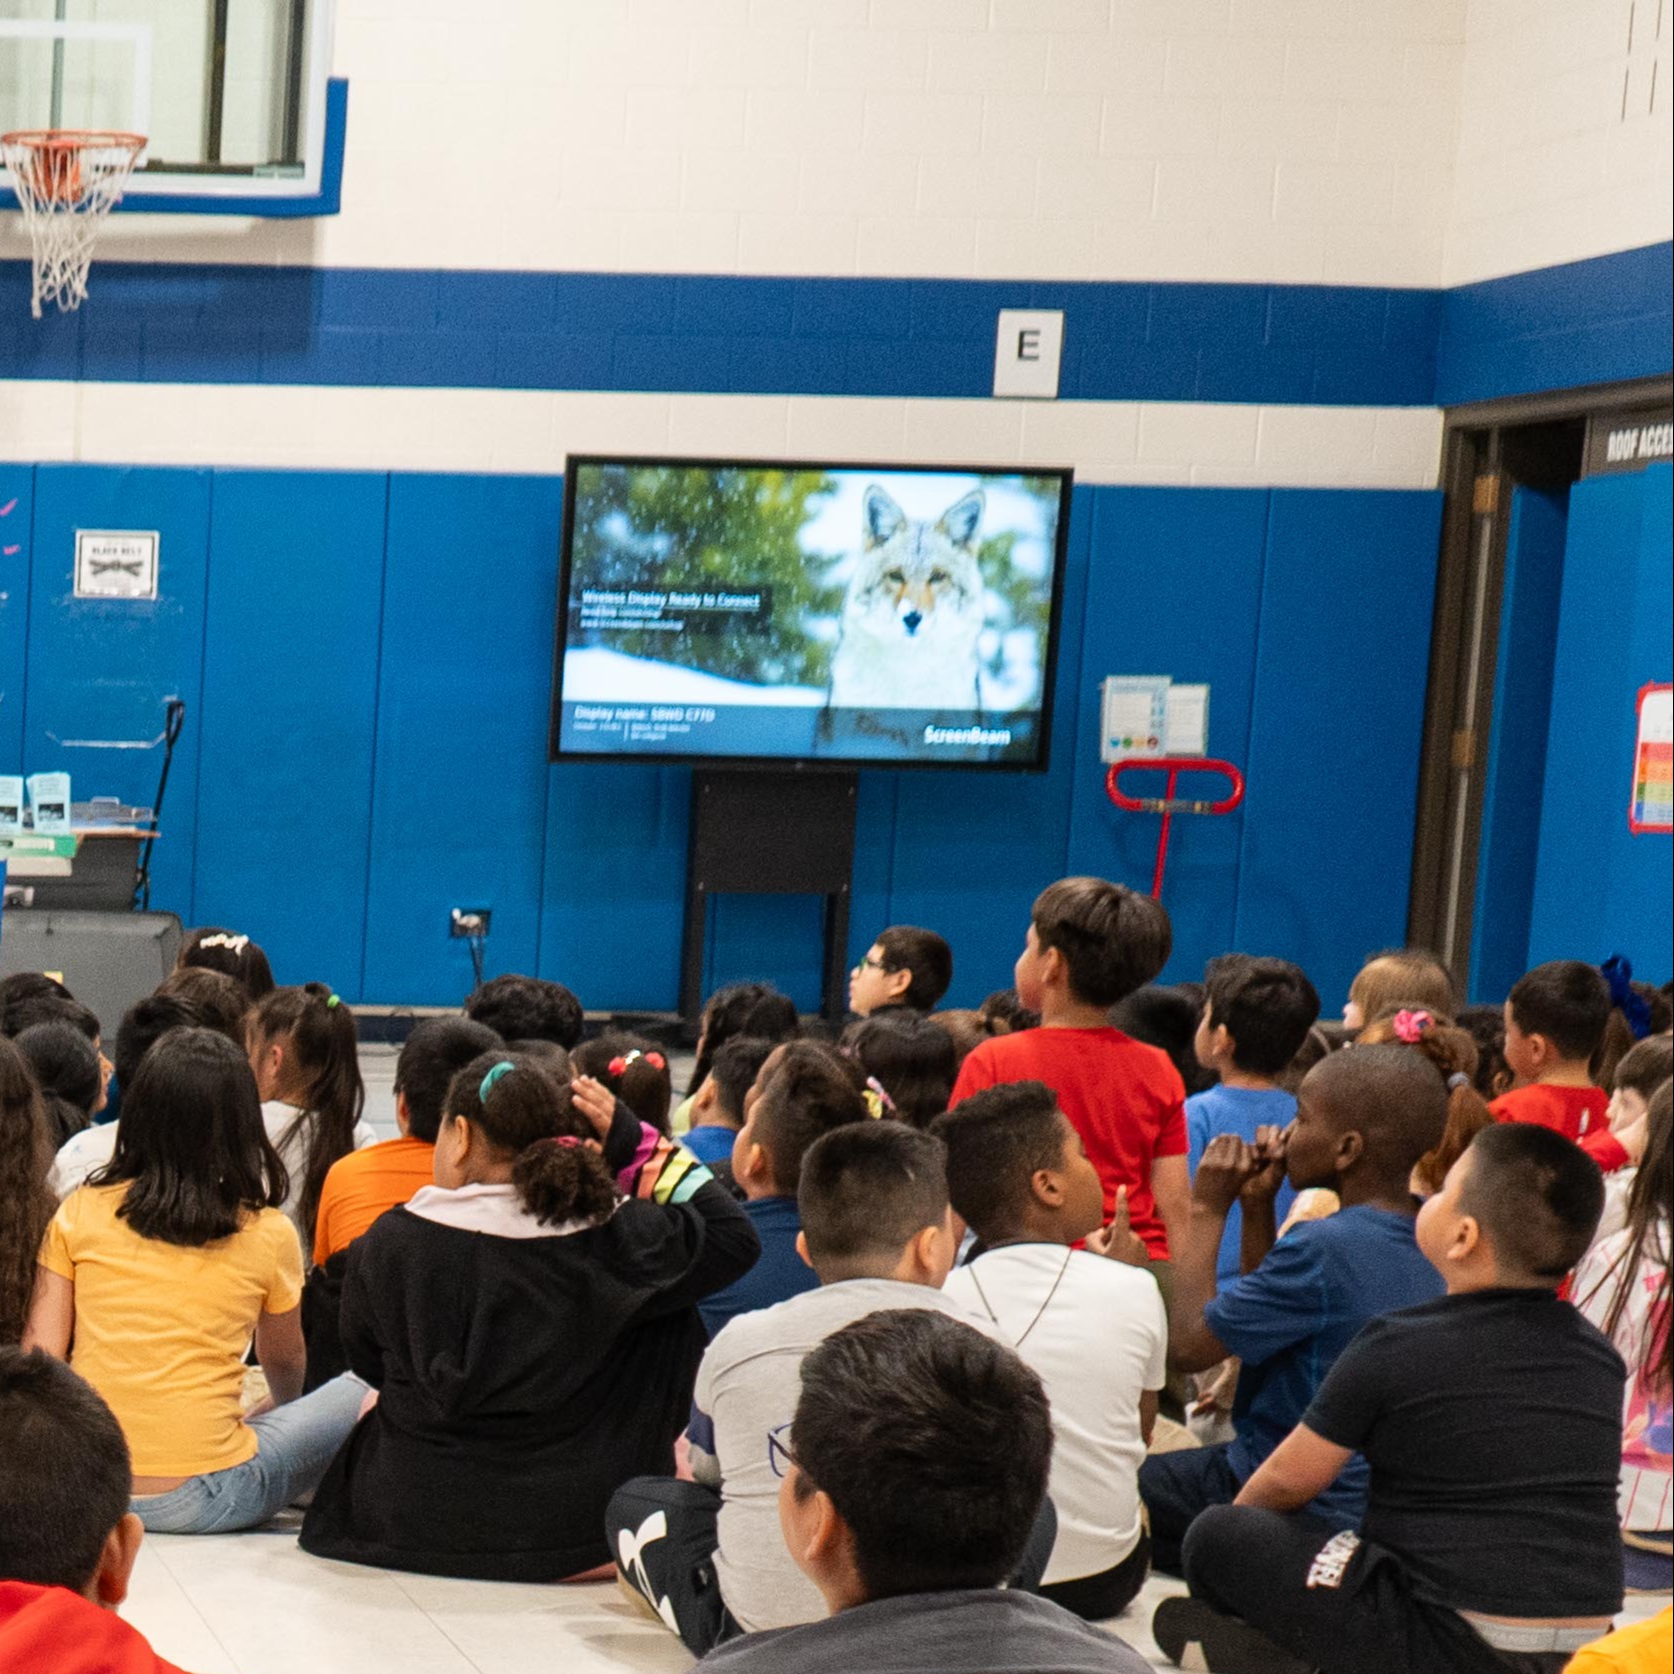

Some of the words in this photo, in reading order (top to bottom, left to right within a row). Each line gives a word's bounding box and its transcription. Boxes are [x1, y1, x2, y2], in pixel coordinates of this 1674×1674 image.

[1016, 329, 1041, 361] E
[1606, 427, 1640, 462] ROOF
[1637, 422, 1673, 459] ACCE
[121, 547, 142, 556] BELT
[628, 590, 667, 608] Display
[668, 591, 702, 609] Ready
[703, 592, 715, 607] to
[717, 592, 761, 607] Connect
[924, 724, 1011, 745] ScreenBeam
